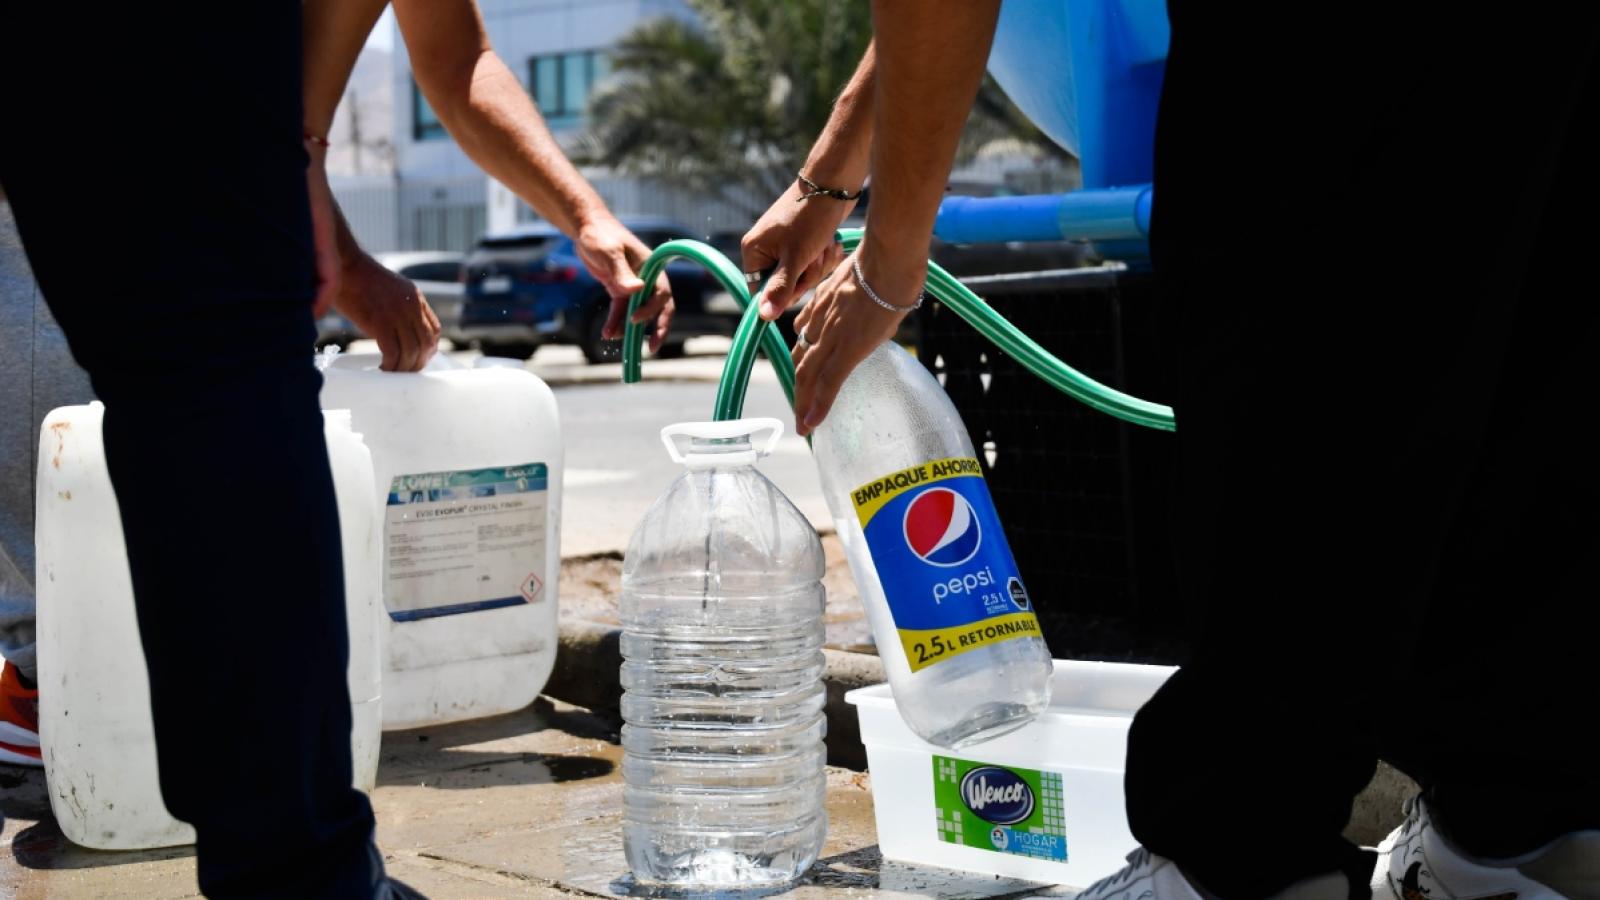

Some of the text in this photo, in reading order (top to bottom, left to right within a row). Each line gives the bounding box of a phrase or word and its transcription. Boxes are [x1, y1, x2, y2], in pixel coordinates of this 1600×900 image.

[855, 467, 928, 506] EMPAQUE
[933, 566, 995, 605] pepsi
[913, 619, 1037, 664] 2.5 L RETORNABLE
[967, 775, 1024, 810] Wenco
[1014, 831, 1058, 849] HOGAR
